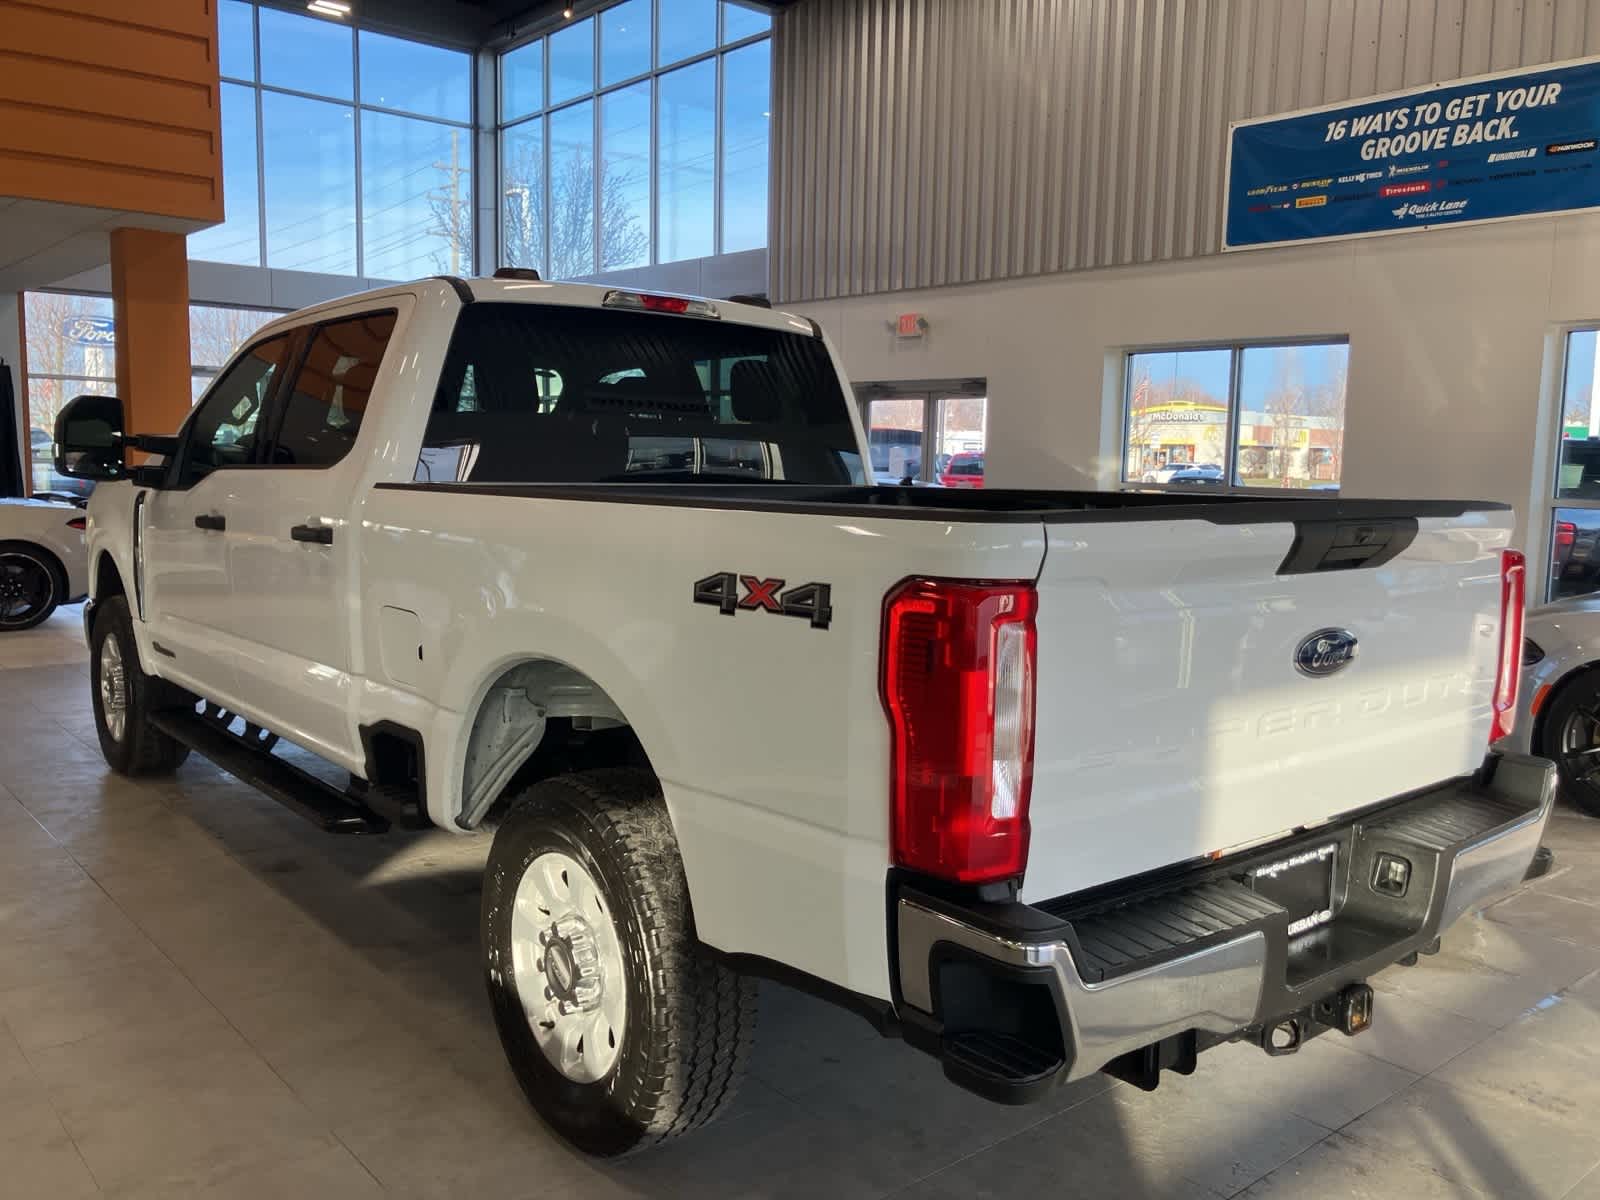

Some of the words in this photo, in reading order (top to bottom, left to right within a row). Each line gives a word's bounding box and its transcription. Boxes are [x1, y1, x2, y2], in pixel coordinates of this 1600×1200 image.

[1325, 120, 1348, 142] 16
[1351, 107, 1410, 138] WAYS
[1414, 102, 1442, 127] TO
[1445, 93, 1491, 121] GET
[1496, 82, 1562, 113] YOUR
[1360, 126, 1451, 160] GROOVE
[1452, 115, 1519, 147] BACK.
[1408, 201, 1439, 214] Quick
[1439, 199, 1468, 211] Lane
